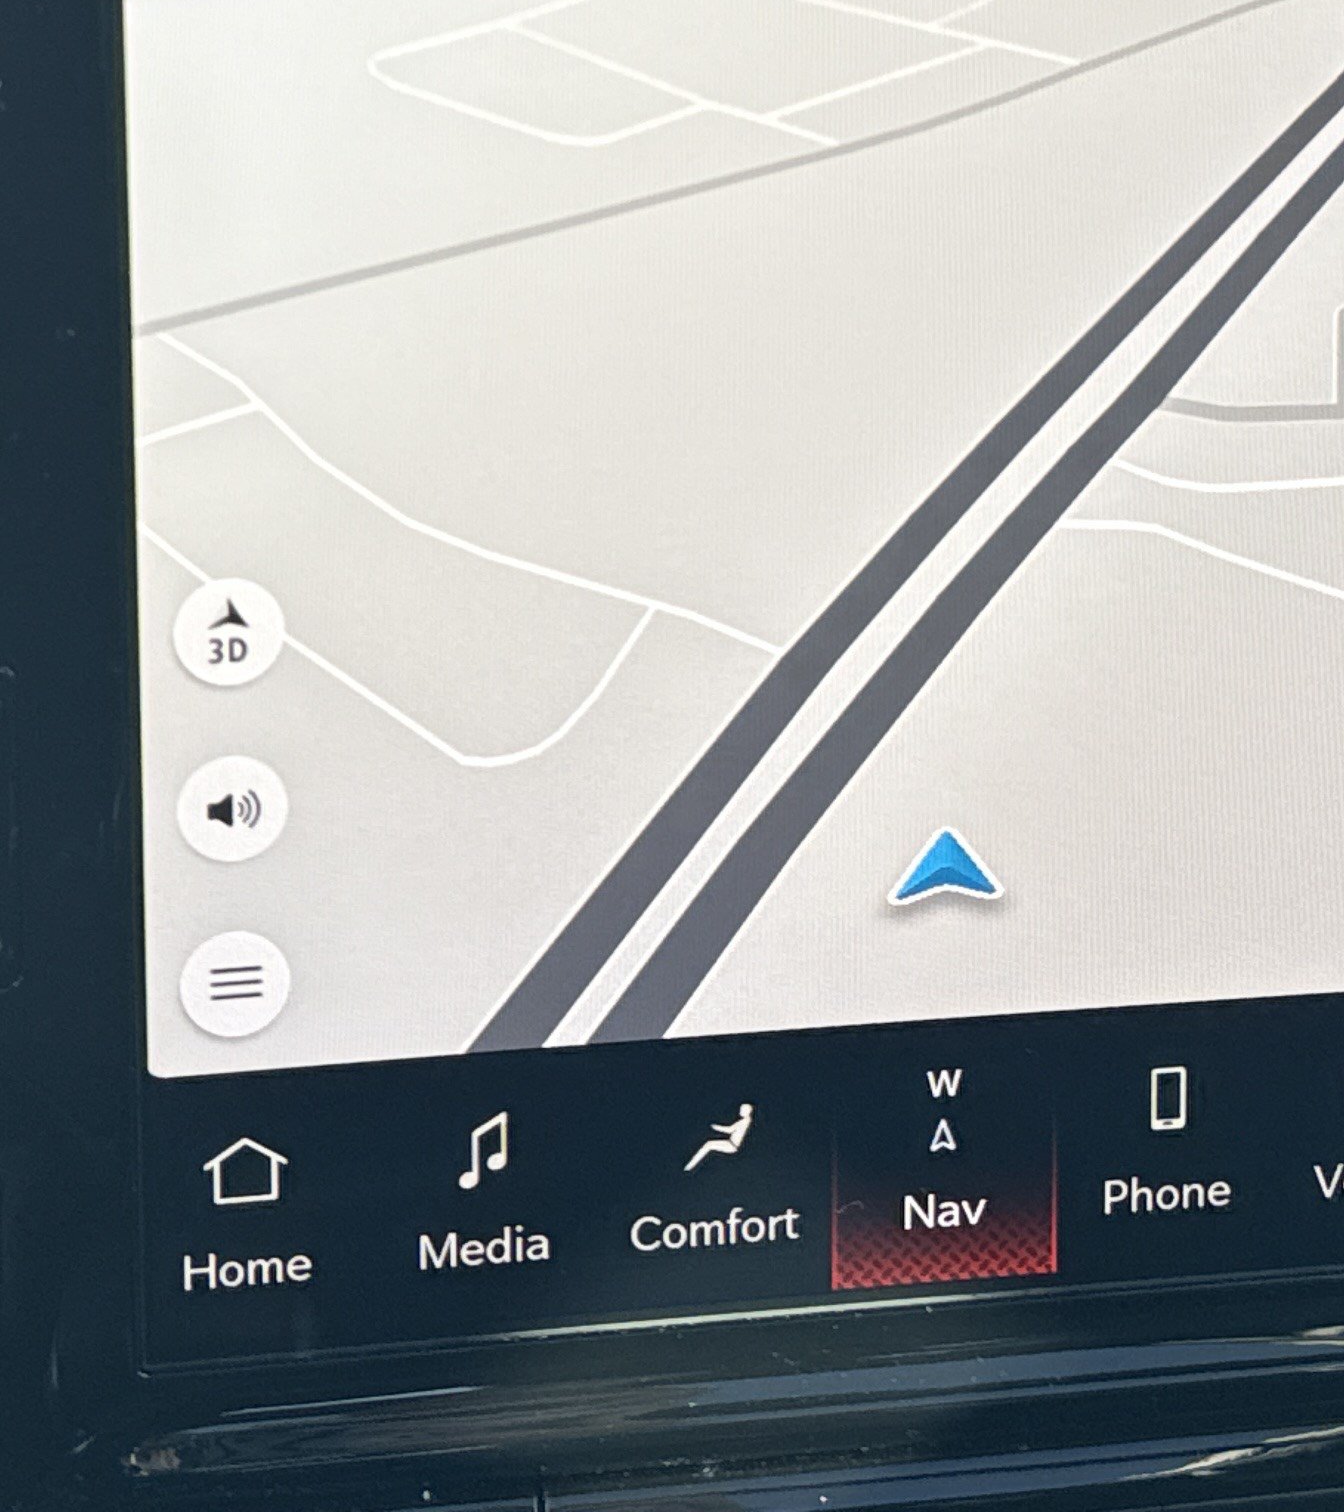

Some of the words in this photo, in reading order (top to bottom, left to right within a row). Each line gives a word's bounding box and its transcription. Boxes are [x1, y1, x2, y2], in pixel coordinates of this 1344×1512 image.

[208, 637, 248, 665] 3D
[926, 1068, 963, 1098] W
[903, 1193, 987, 1231] Nav
[1104, 1176, 1232, 1215] Phone
[419, 1224, 550, 1271] Media
[630, 1206, 800, 1251] Comfort
[183, 1252, 313, 1292] Home
